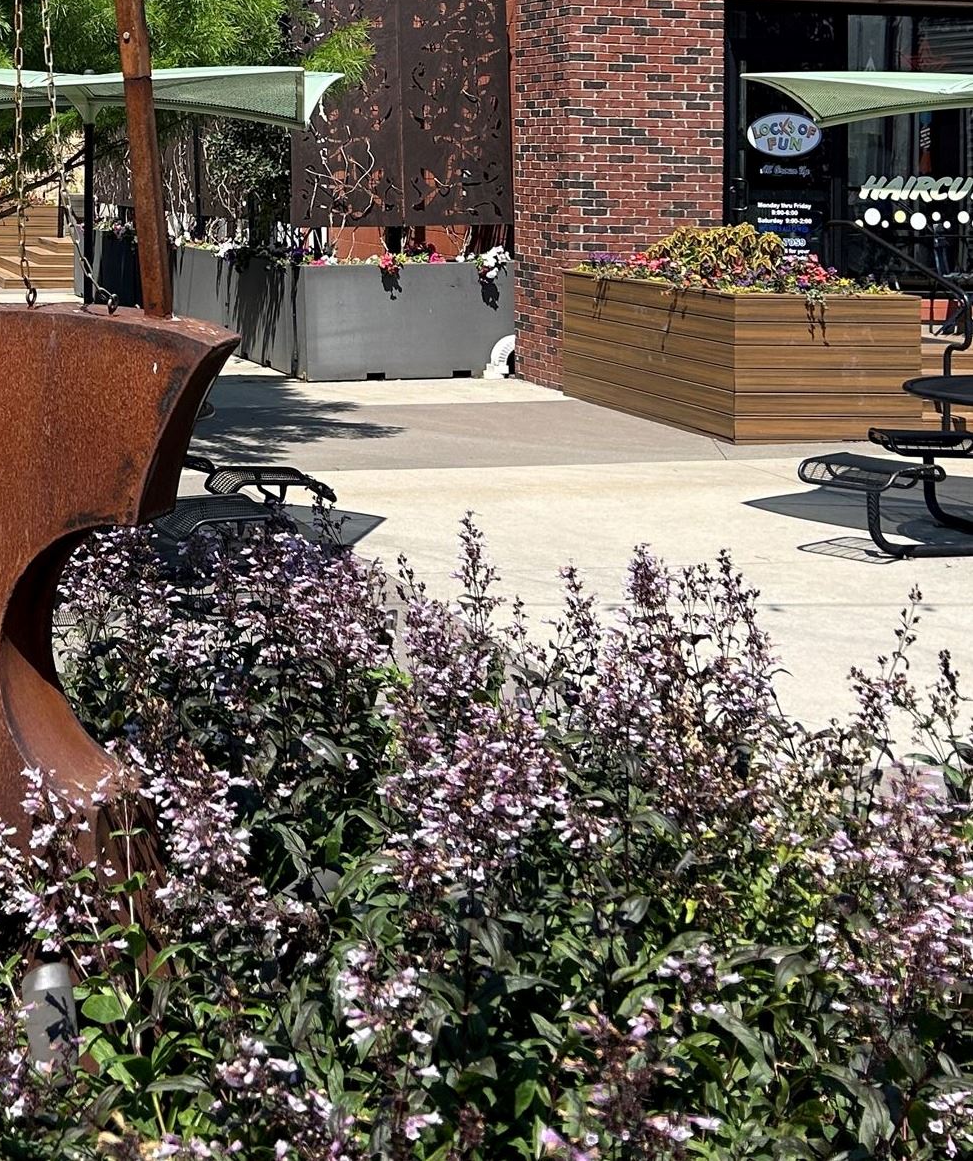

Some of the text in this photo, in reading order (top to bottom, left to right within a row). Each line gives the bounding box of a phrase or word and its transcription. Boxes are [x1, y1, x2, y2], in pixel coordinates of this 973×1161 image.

[752, 117, 817, 139] LOCKS OF
[767, 137, 802, 151] FUN
[858, 175, 973, 202] HAIRCU
